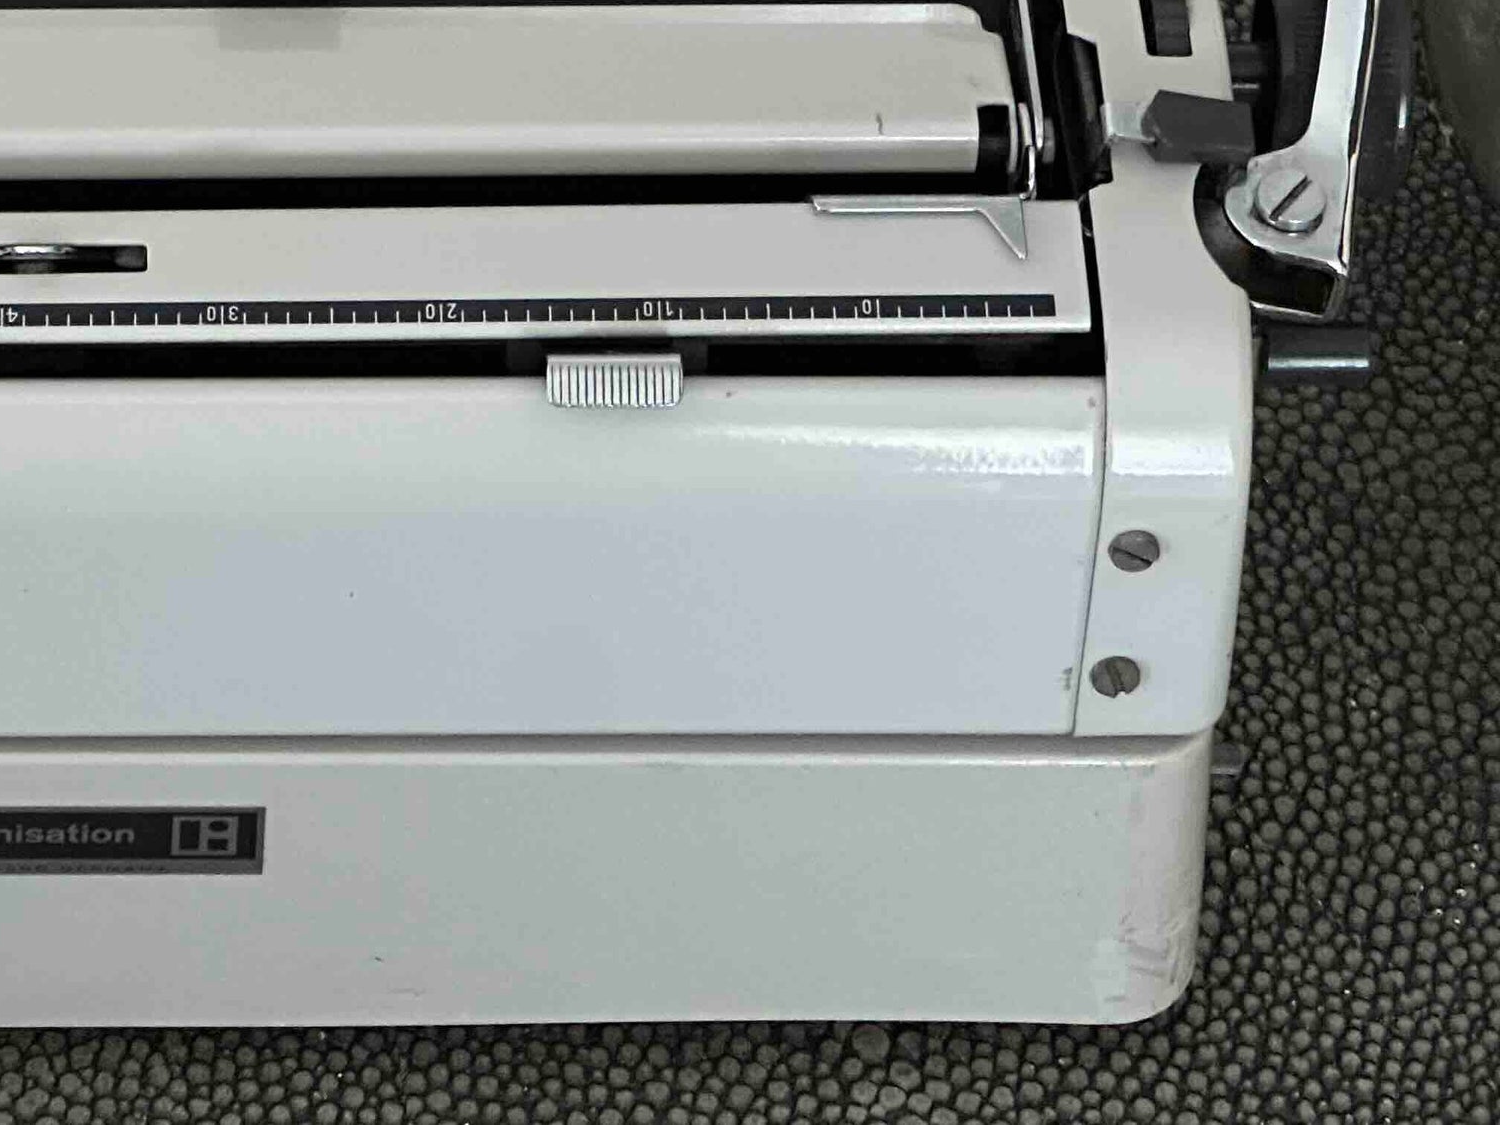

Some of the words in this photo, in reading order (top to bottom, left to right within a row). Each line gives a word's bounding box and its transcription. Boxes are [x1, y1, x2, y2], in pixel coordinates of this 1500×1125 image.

[206, 305, 239, 322] 30
[425, 303, 458, 319] 20
[642, 301, 674, 317] 10
